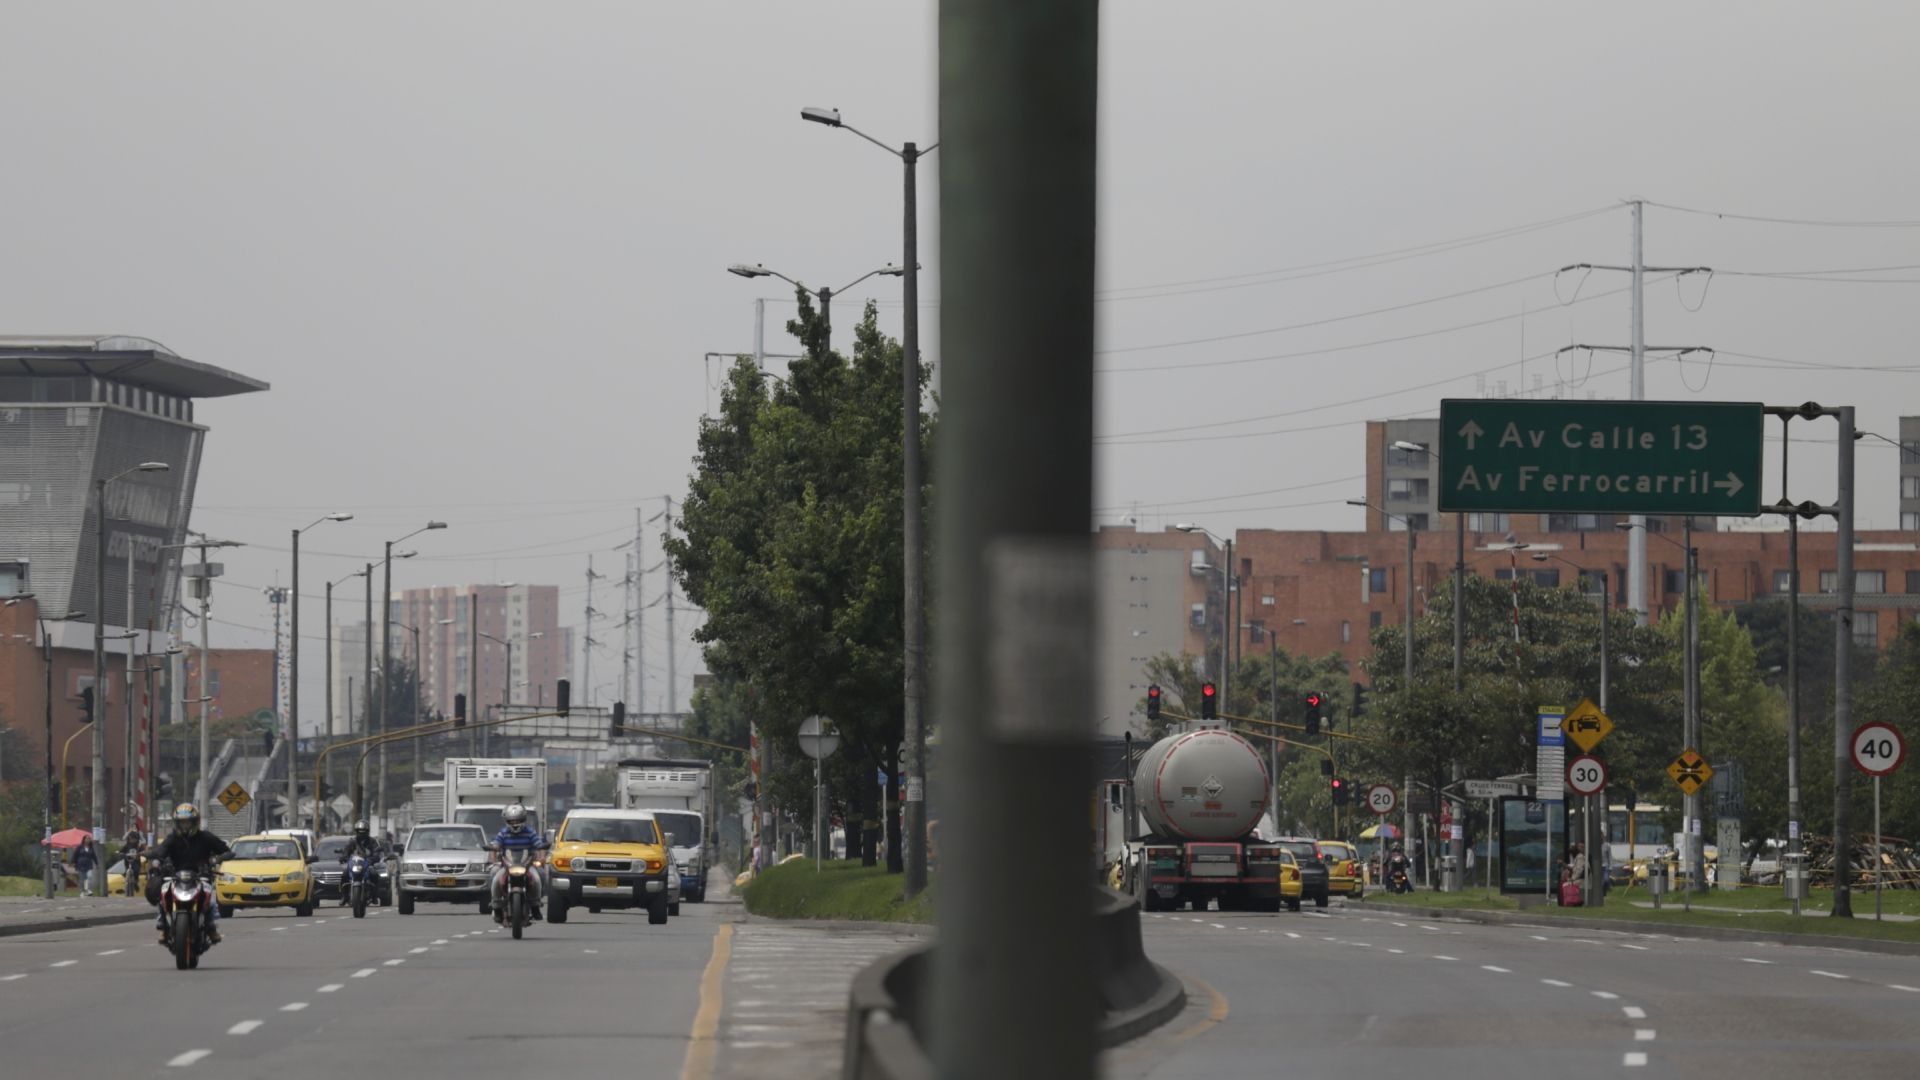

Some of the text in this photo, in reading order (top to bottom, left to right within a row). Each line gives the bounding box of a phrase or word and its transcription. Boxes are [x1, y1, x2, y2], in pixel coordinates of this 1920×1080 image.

[1499, 421, 1708, 450] Av Calle 13
[1456, 465, 1709, 493] Av Ferrocarril
[1861, 739, 1893, 758] 40
[1576, 768, 1598, 783] 30
[1373, 793, 1391, 805] 20
[1527, 802, 1542, 812] 22
